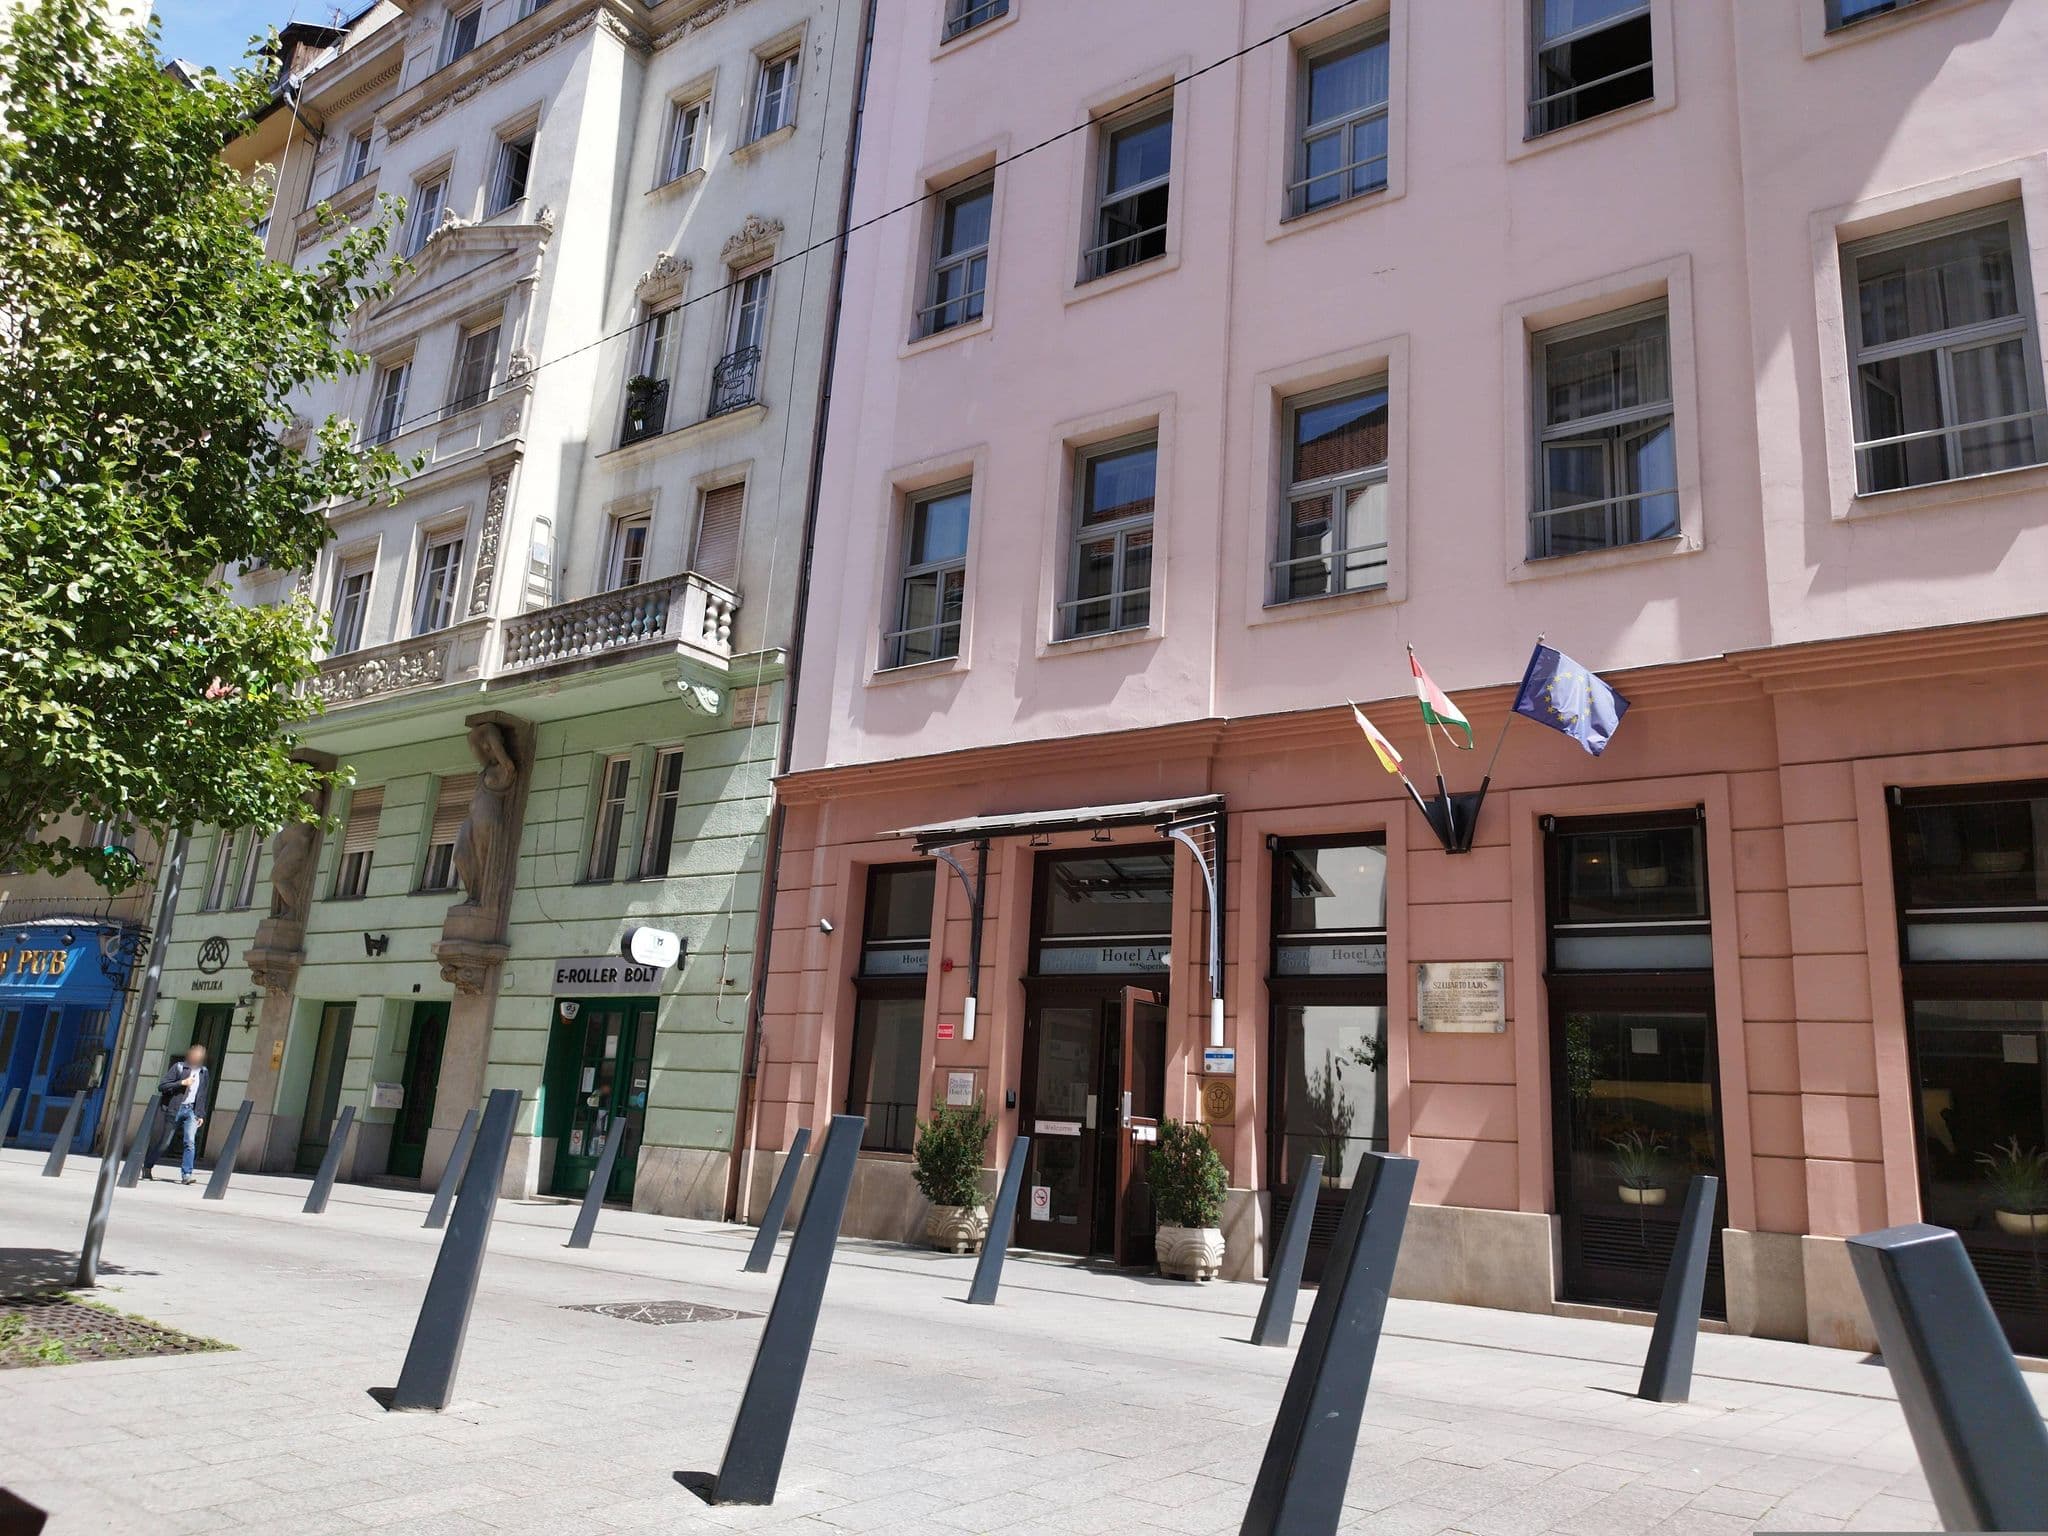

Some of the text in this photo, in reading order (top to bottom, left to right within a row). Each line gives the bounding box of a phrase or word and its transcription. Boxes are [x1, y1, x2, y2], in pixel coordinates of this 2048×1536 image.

[1102, 948, 1141, 962] Hotel
[1332, 949, 1367, 960] Hotel
[18, 950, 68, 975] PUB
[556, 967, 658, 983] E-ROLLER BOLT
